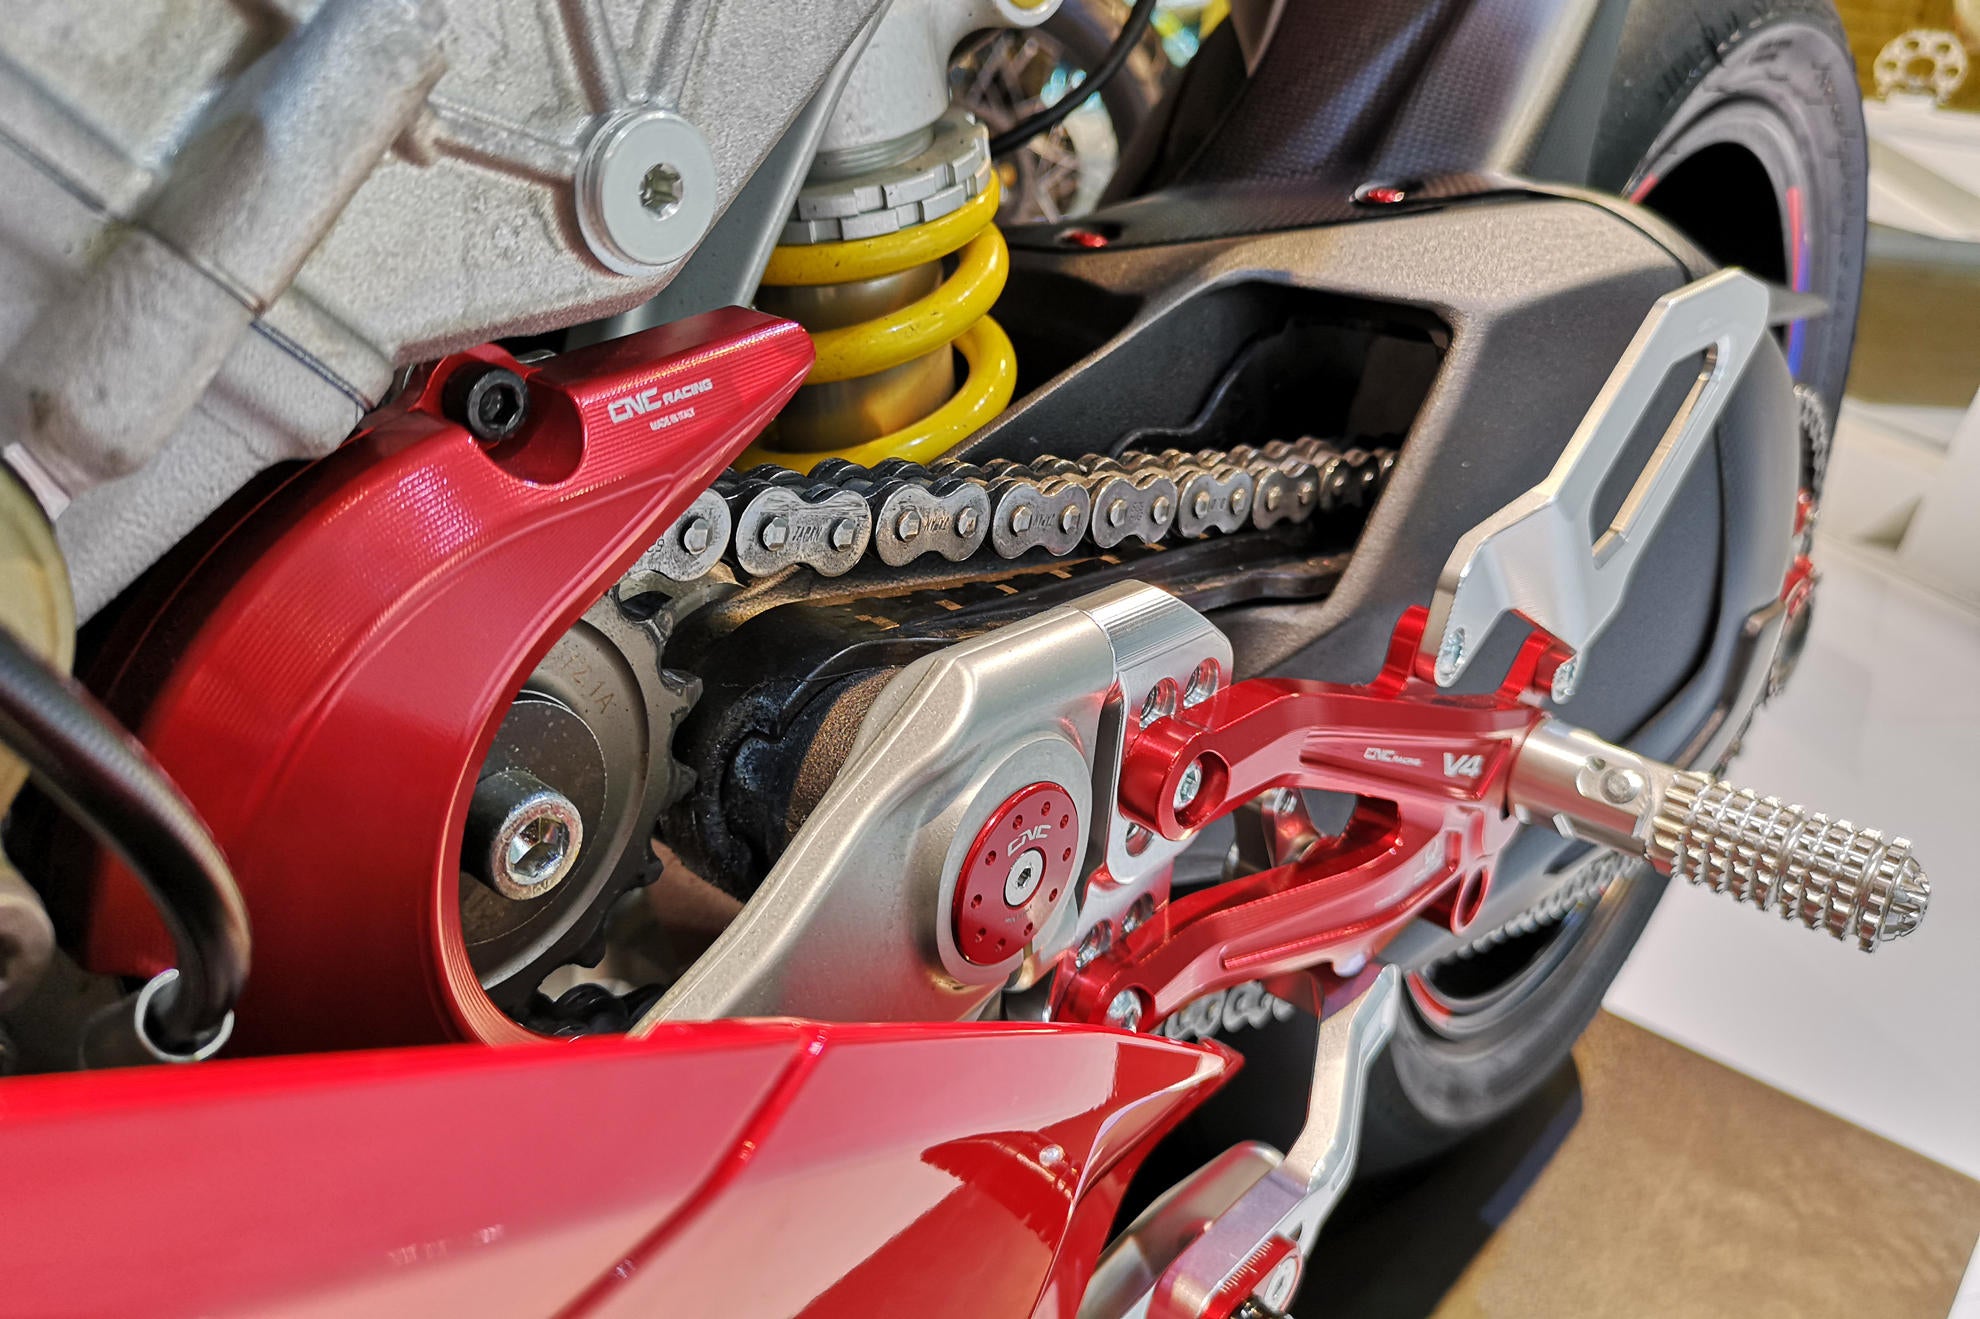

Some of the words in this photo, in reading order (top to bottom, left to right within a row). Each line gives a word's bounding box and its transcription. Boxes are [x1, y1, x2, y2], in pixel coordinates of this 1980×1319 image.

[607, 387, 662, 424] CNC
[662, 378, 714, 405] RACING
[791, 525, 823, 543] JAPAN
[1363, 747, 1396, 763] CNC
[1442, 752, 1484, 778] V4
[1007, 824, 1053, 857] CNC
